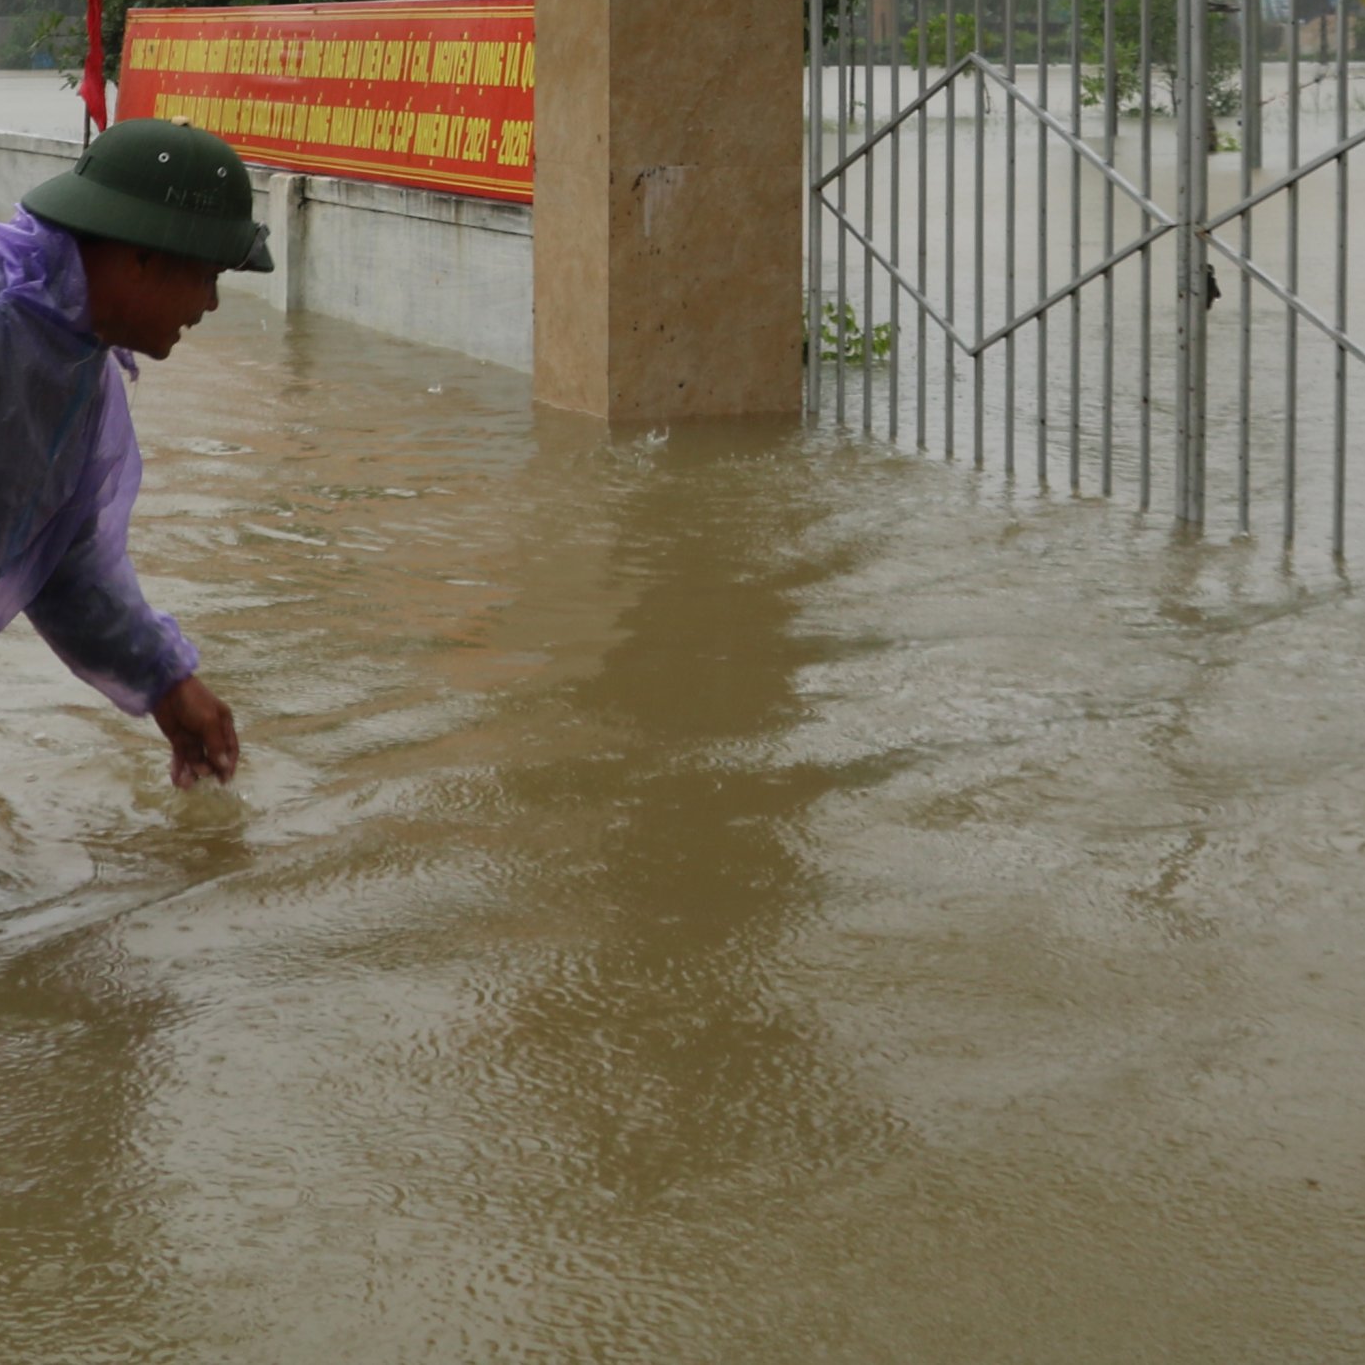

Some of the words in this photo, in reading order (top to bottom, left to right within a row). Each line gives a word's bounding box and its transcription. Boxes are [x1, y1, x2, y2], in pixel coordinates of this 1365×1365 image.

[359, 31, 385, 89] DIỆN
[382, 40, 404, 82] CHO
[403, 31, 413, 82] Ý
[430, 31, 475, 95] NGUYỆN
[473, 41, 505, 96] VỌNG
[504, 31, 522, 88] VÀ
[328, 98, 356, 147] NHÂN
[353, 99, 376, 149] DÂN
[373, 99, 395, 152] CÁC
[393, 95, 415, 154] CẤP
[412, 104, 450, 167] NHIỆM
[446, 106, 465, 160] KỲ
[461, 116, 491, 163] 2021
[497, 119, 534, 167] 2026!
